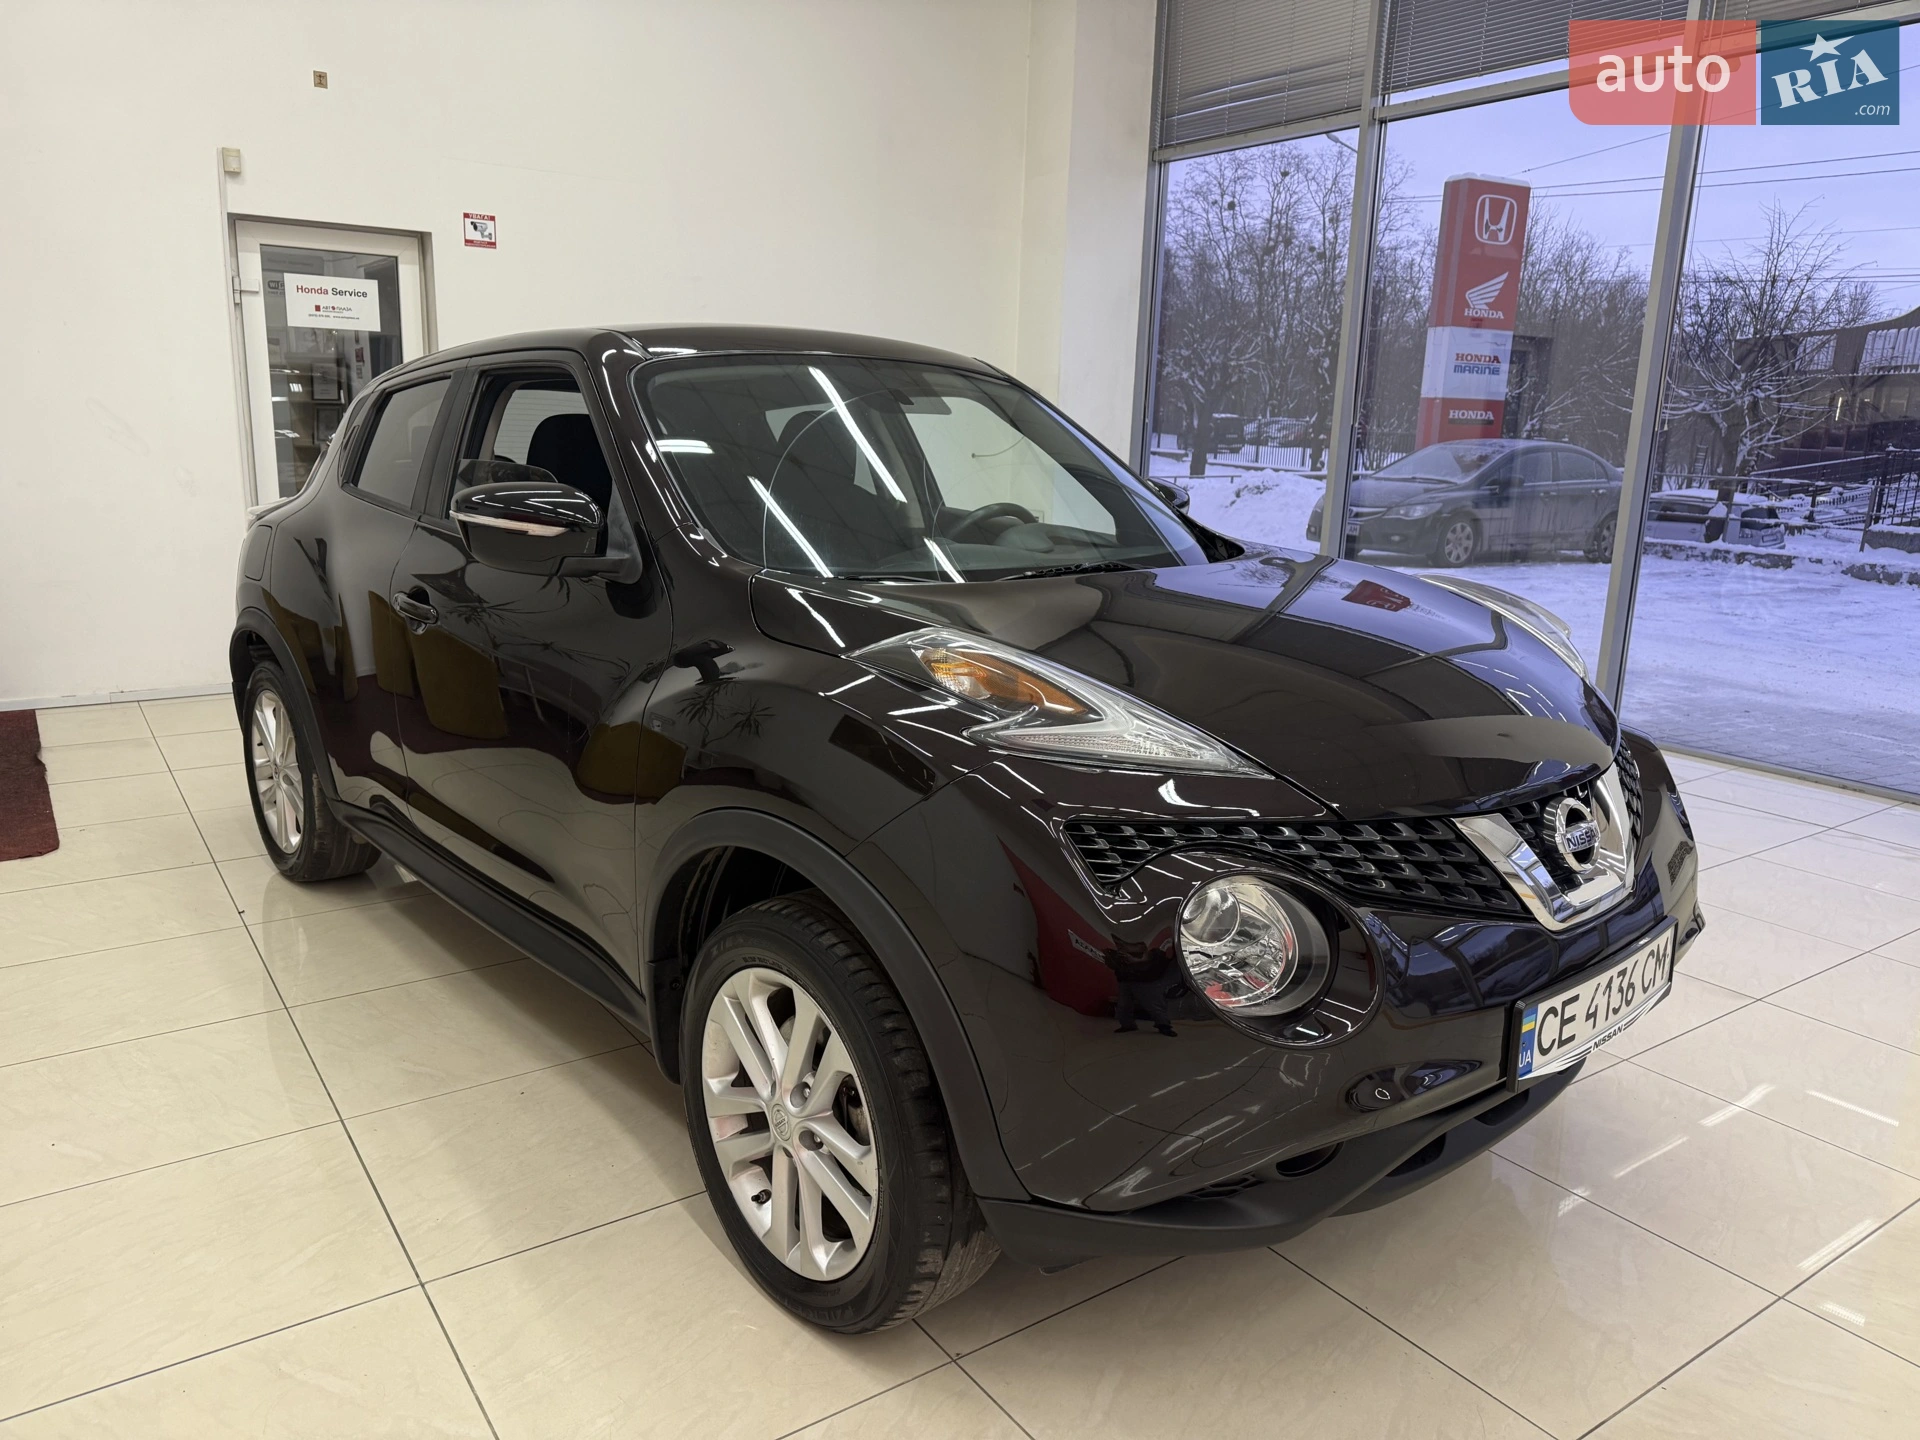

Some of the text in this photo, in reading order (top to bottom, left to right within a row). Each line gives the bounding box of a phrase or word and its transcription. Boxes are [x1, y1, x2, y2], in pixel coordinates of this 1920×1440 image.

[296, 284, 329, 295] Honda
[331, 287, 368, 298] Service
[1463, 308, 1504, 319] HONDA
[1455, 352, 1501, 364] HONDA
[1453, 364, 1501, 376] MARINE
[1448, 409, 1495, 420] HONDA
[1537, 936, 1669, 1056] CE 4136 CM
[1592, 1023, 1624, 1051] NISSAN
[1519, 1050, 1532, 1067] UA
